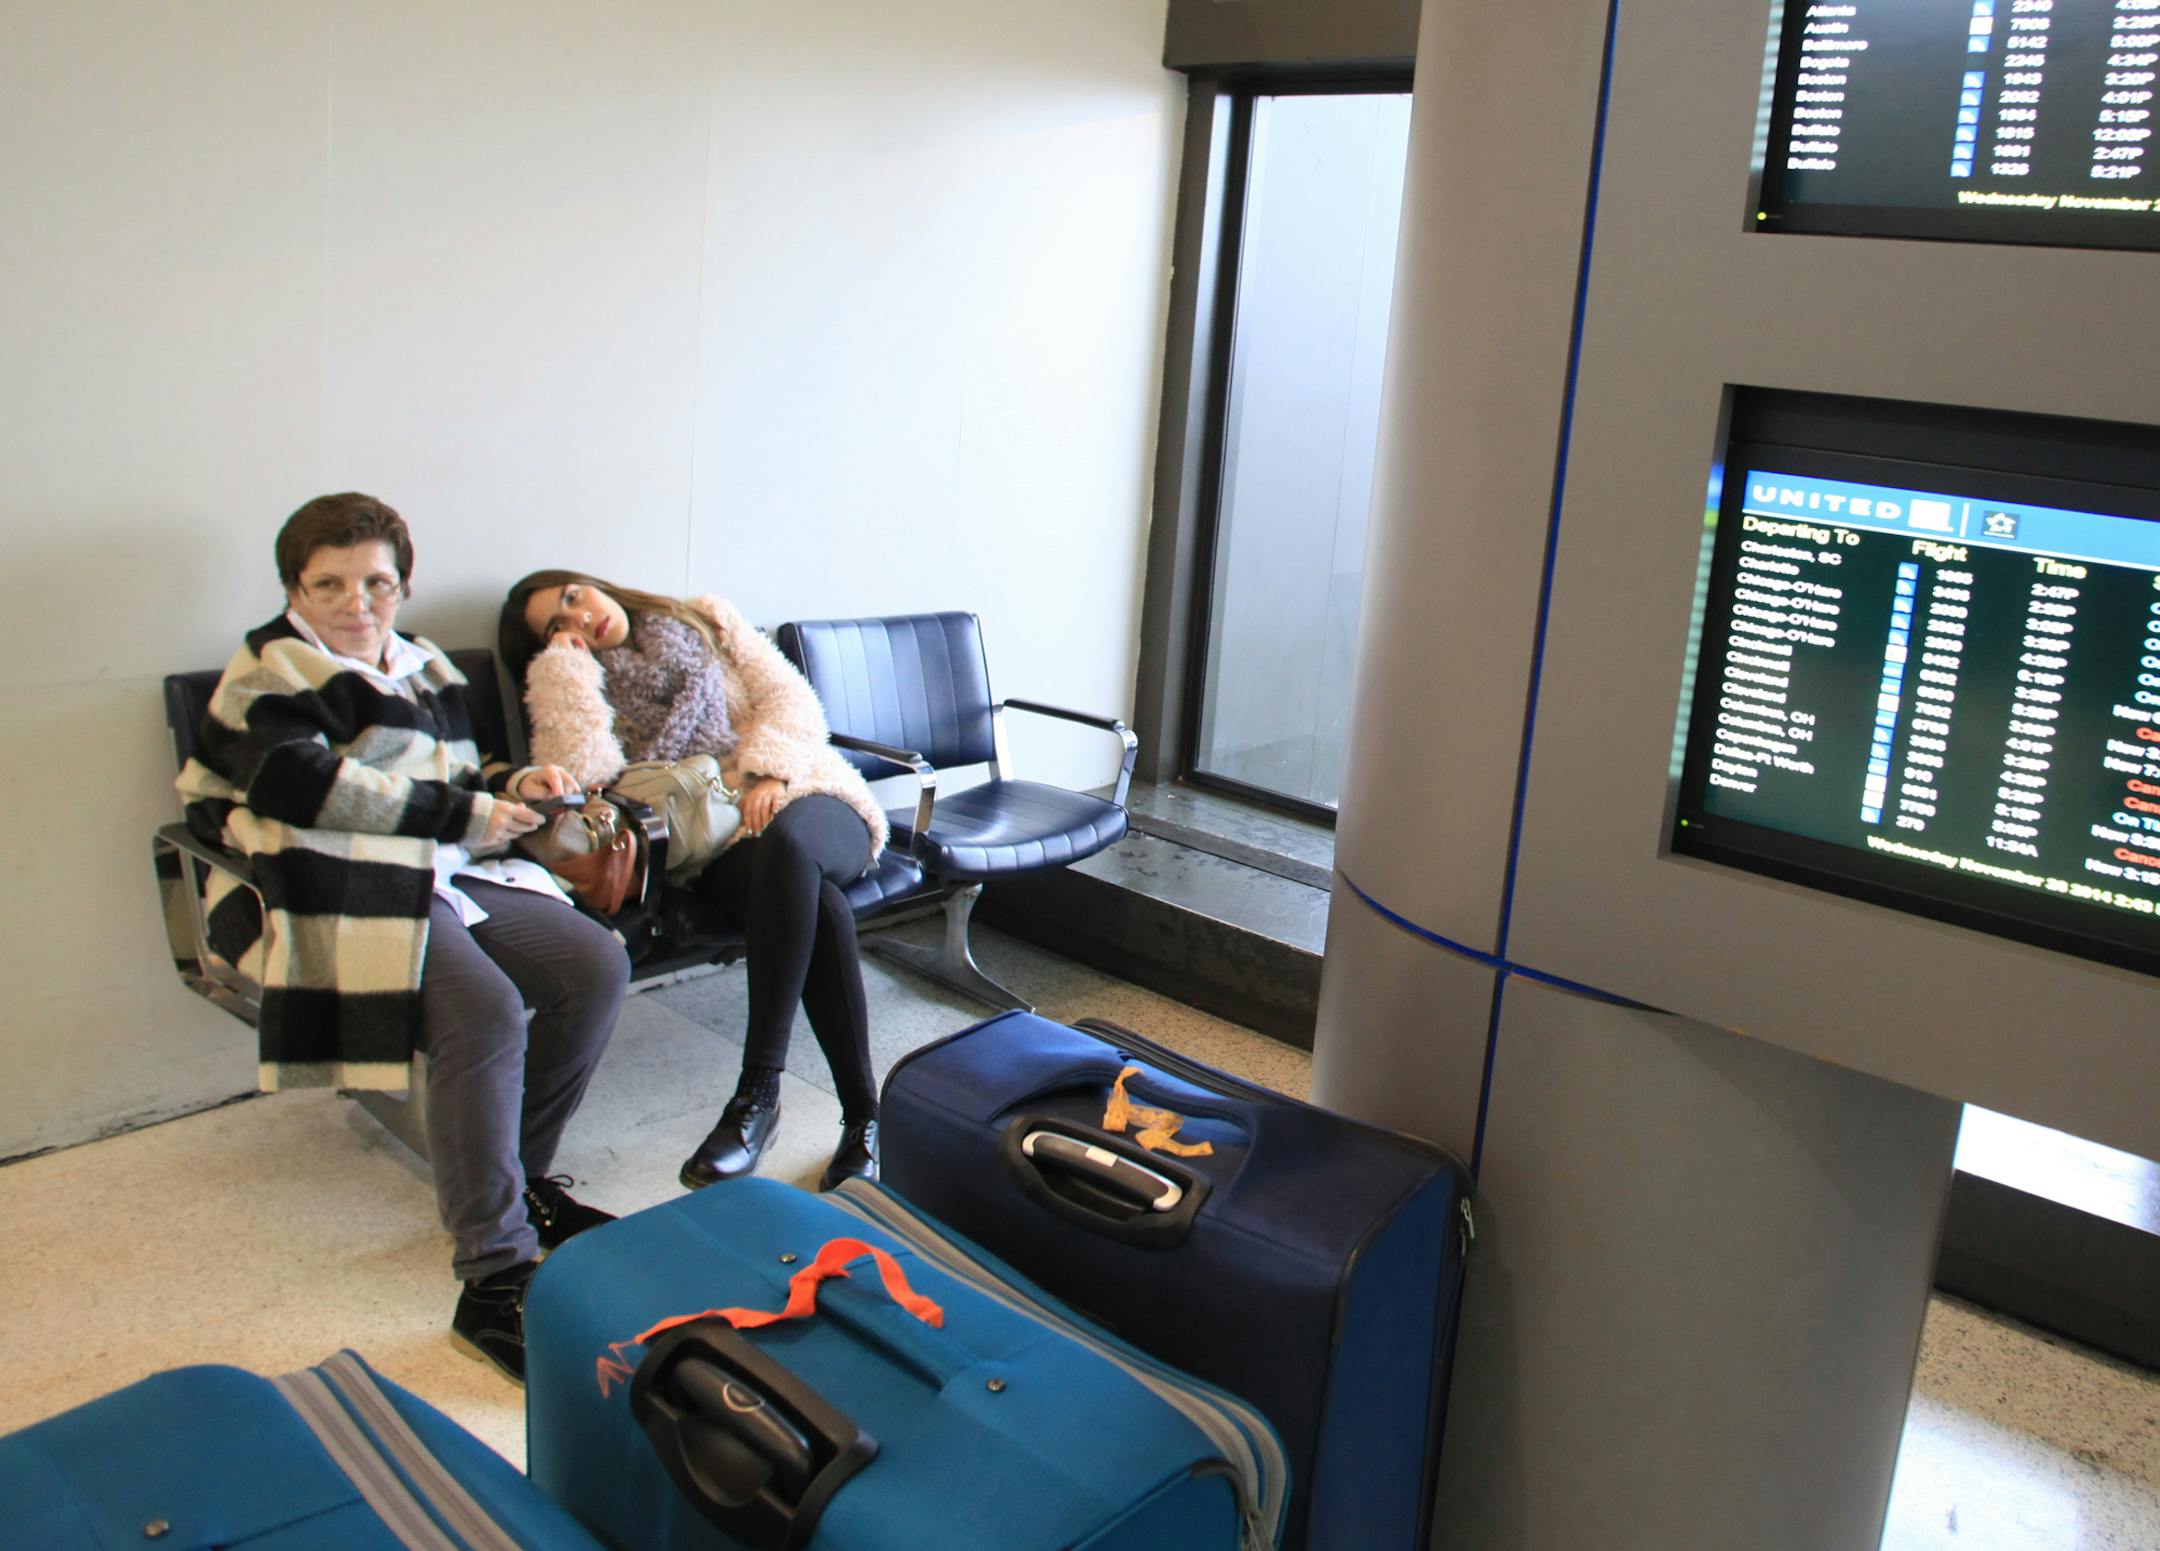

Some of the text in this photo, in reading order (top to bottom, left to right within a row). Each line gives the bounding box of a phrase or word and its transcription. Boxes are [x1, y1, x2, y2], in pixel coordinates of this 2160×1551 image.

[1806, 5, 1856, 17] Atlanta
[1804, 21, 1850, 35] Austin
[1802, 39, 1869, 51] Baltimore
[1800, 56, 1850, 71] Bogota
[1798, 73, 1847, 85] Boston
[1796, 90, 1845, 102] Boston
[2101, 91, 2152, 104] 4:01P
[1794, 107, 1842, 119] Boston
[1792, 124, 1840, 136] Buffalo
[1790, 141, 1838, 153] Buffalo
[2093, 147, 2144, 160] 2:47P
[1787, 158, 1836, 170] Buffalo
[1958, 191, 2057, 209] Wednesday
[2059, 194, 2152, 211] November
[1752, 485, 1901, 520] UNITED
[1742, 516, 2087, 579] Departing To Flight Time
[1739, 557, 1800, 575] Charlotte
[1818, 552, 1841, 565] SC
[2031, 583, 2079, 600] 2:47P
[1724, 666, 1789, 688] Cleveland
[1722, 682, 1787, 704] Cleveland
[1790, 711, 1815, 725] OH
[1716, 728, 1797, 754] Copenhagen
[1788, 727, 1813, 741] OH
[1712, 758, 1758, 778] Dayton
[1710, 773, 1757, 793] Denver
[1773, 755, 1814, 774] Worth
[2112, 811, 2140, 828] On
[1867, 835, 1959, 869] Wednesday
[1959, 857, 2044, 888] November
